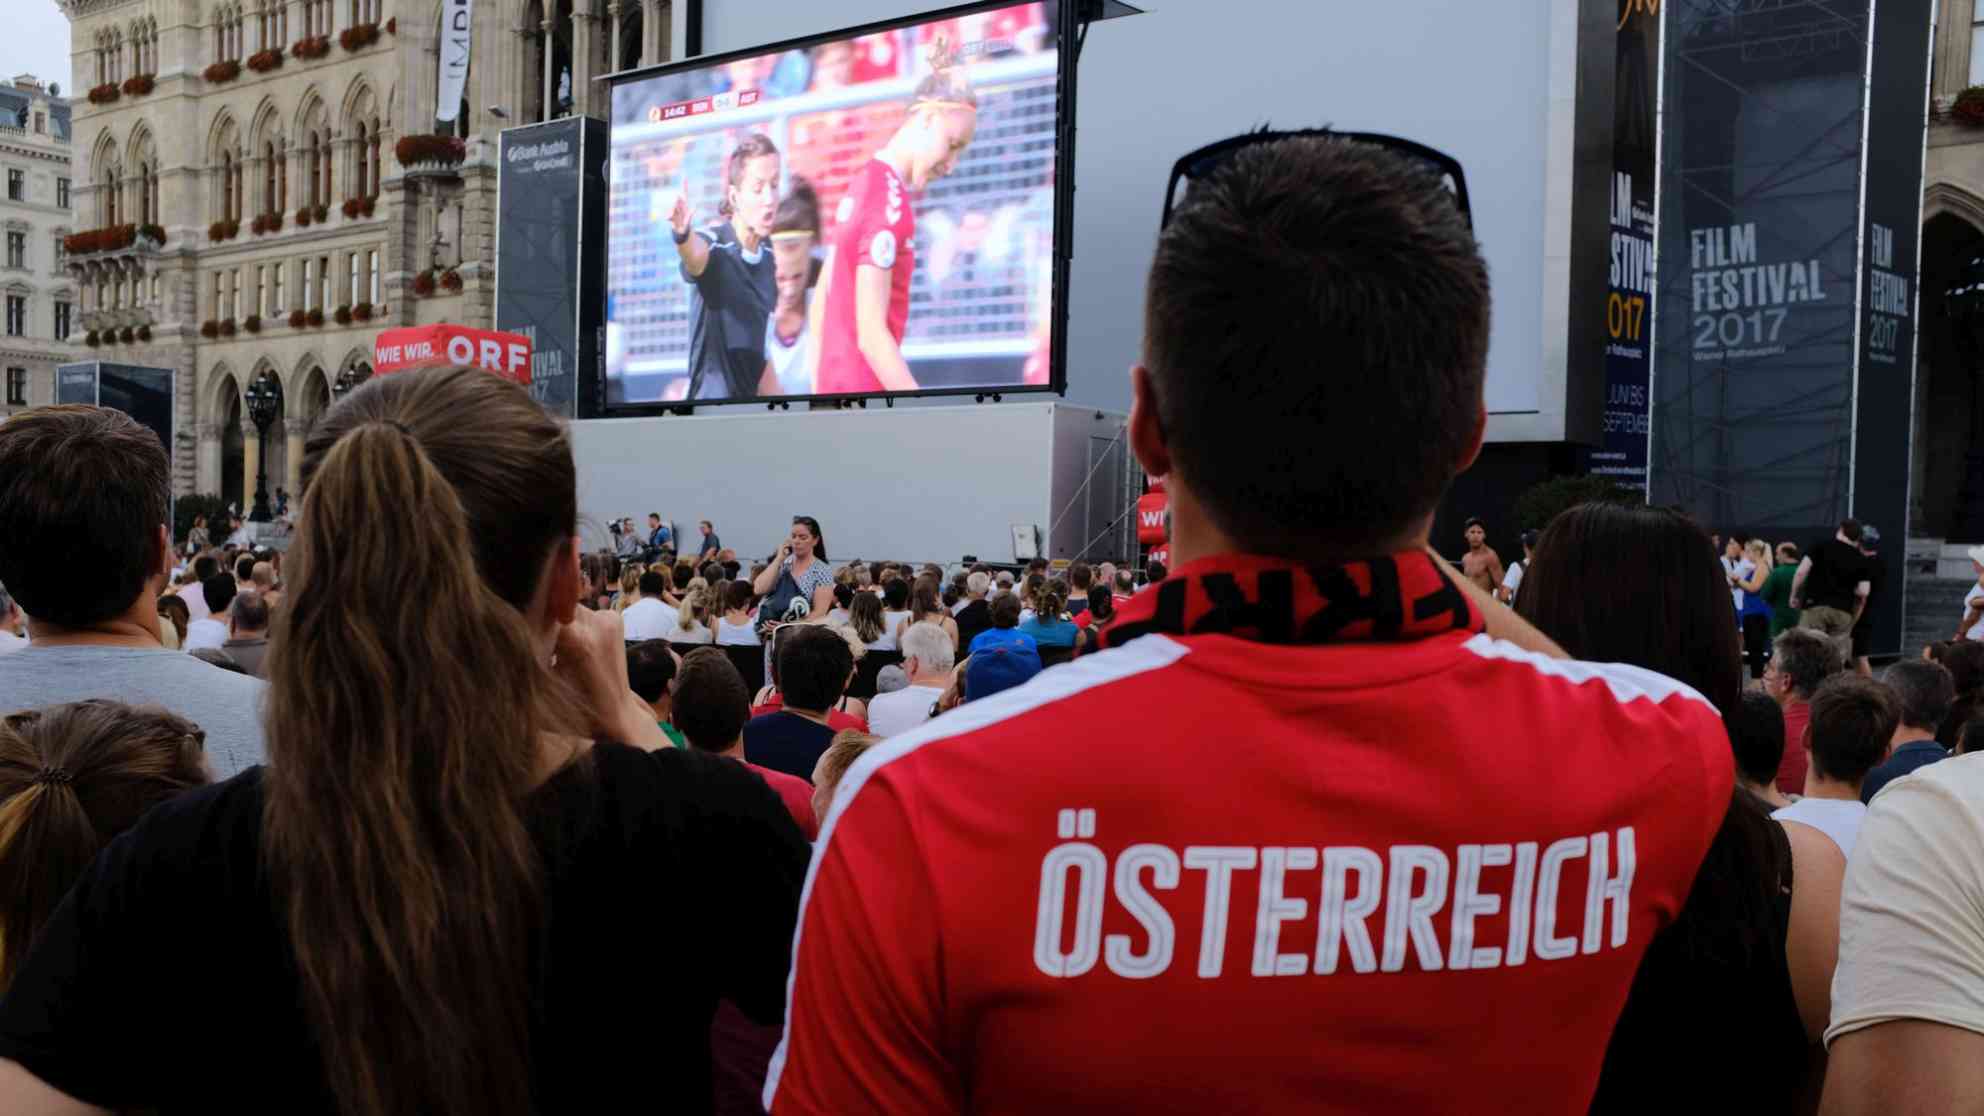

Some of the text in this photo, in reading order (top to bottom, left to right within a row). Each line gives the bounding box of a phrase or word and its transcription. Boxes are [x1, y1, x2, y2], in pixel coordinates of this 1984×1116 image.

[1691, 222, 1756, 269] FILM
[1872, 223, 1893, 269] FILM
[1692, 259, 1826, 312] FESTIVAL
[1871, 268, 1908, 317] FESTIVAL
[1693, 307, 1787, 349] 2017
[1870, 311, 1898, 353] 2017
[376, 344, 401, 365] WIE
[447, 335, 529, 373] ORF
[1033, 808, 1636, 980] ÖSTERREICH
